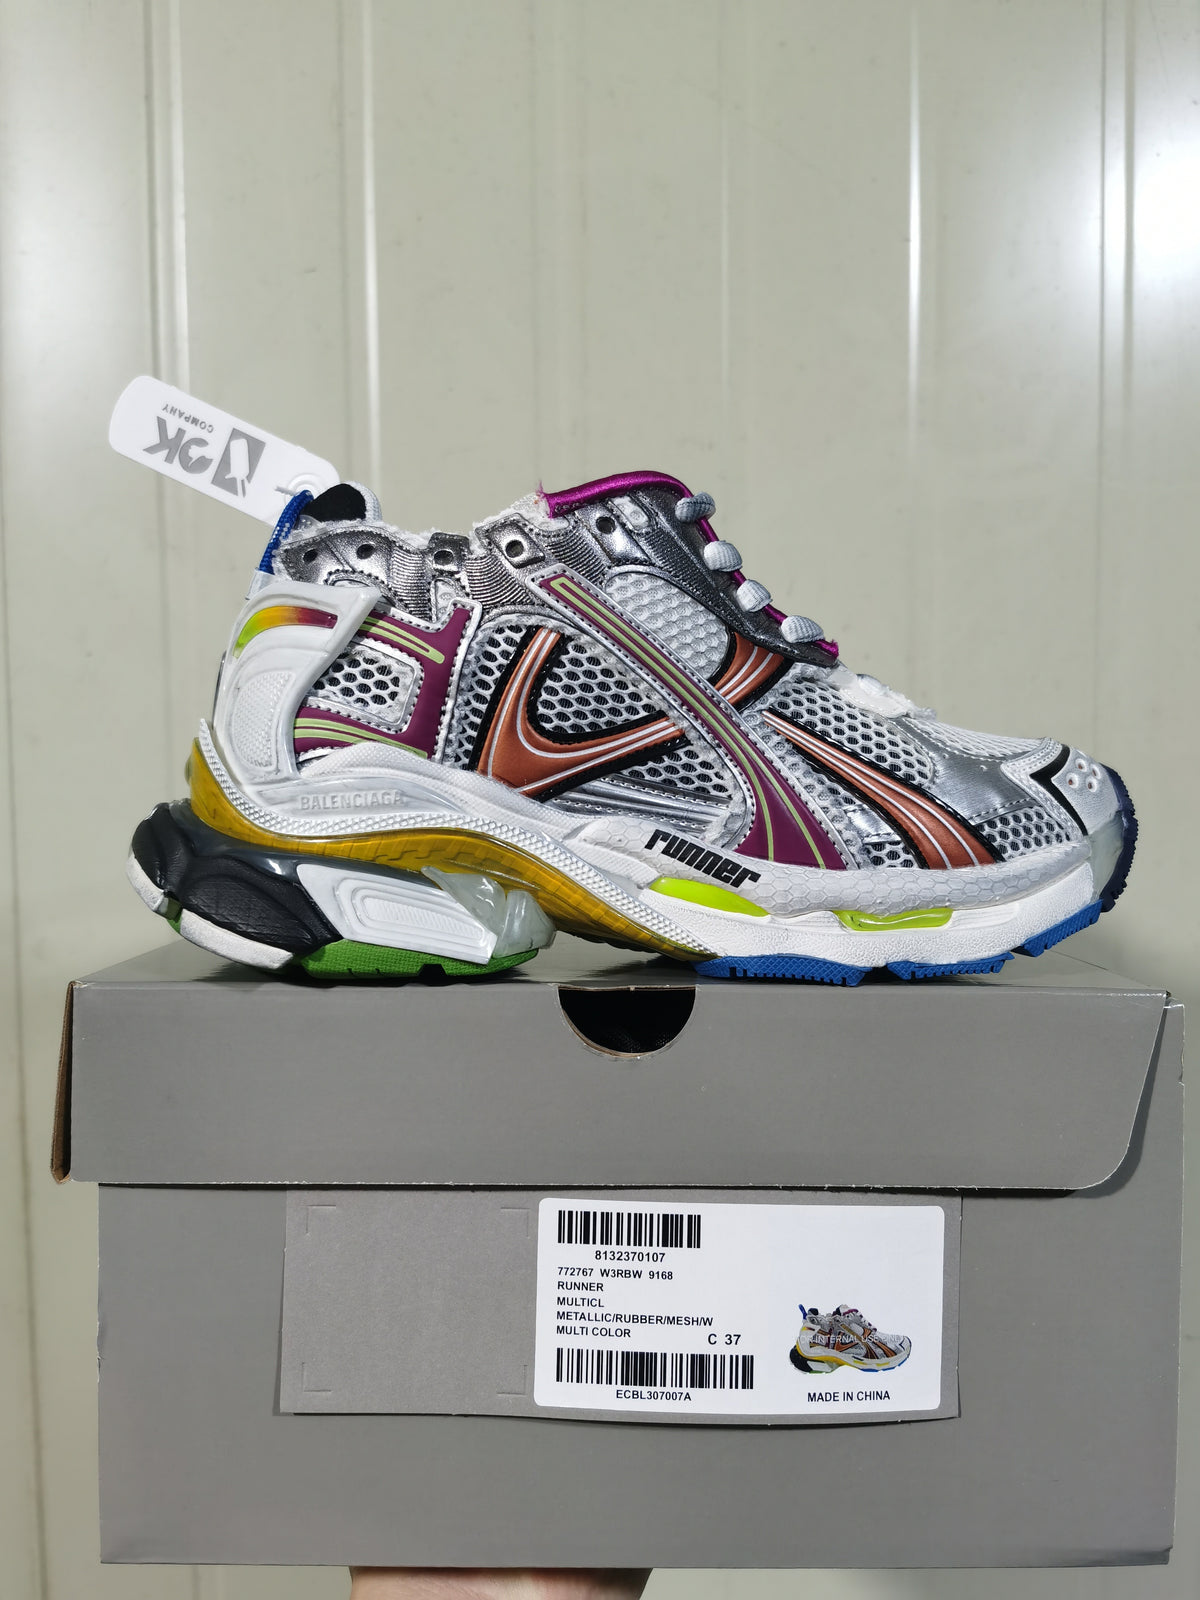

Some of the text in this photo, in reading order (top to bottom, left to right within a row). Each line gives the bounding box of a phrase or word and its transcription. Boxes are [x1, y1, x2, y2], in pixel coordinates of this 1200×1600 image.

[162, 403, 214, 433] COMPANY
[300, 790, 405, 811] BALENCIAGA
[644, 829, 762, 888] runner
[595, 1250, 665, 1262] 8132370107
[558, 1267, 673, 1280] 772767 W3RBW 9168
[558, 1281, 603, 1291] RUNNER
[557, 1297, 604, 1307] MULTICL
[557, 1311, 713, 1326] METALLIC/RUBBER/MESH/W
[557, 1325, 630, 1337] MULTI COLOR
[708, 1334, 741, 1345] C 37
[616, 1390, 691, 1401] ECBL307007A
[808, 1391, 890, 1402] MADE IN CHINA
